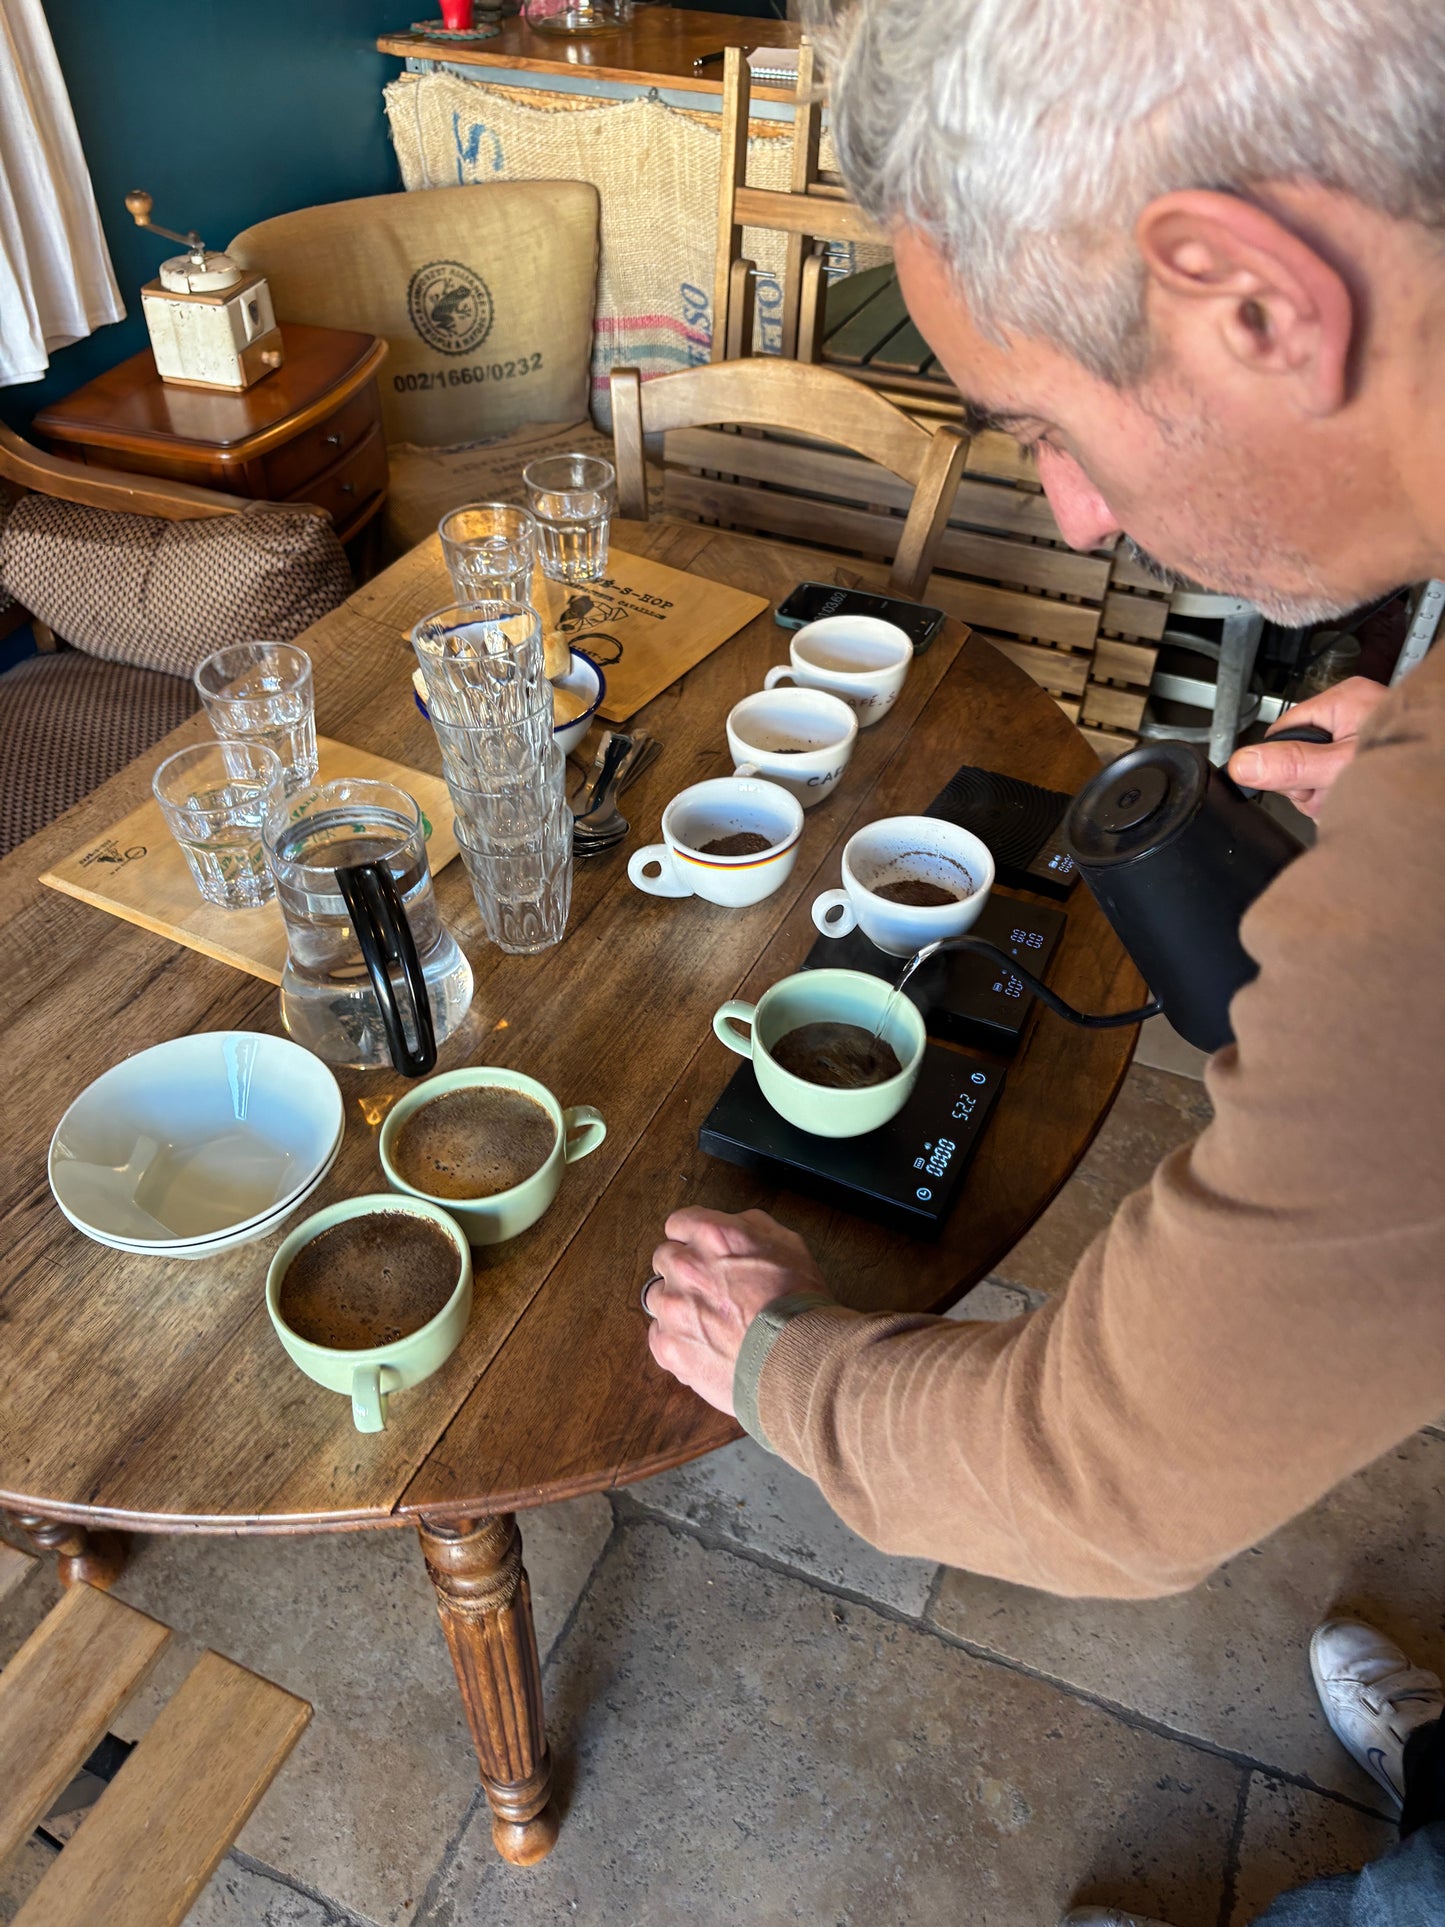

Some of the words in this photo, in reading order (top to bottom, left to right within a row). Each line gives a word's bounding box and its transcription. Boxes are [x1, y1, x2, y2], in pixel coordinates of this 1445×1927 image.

[393, 352, 544, 393] 002/1660/0232
[951, 1093, 977, 1121] 52.2
[925, 1137, 957, 1178] 00:00
